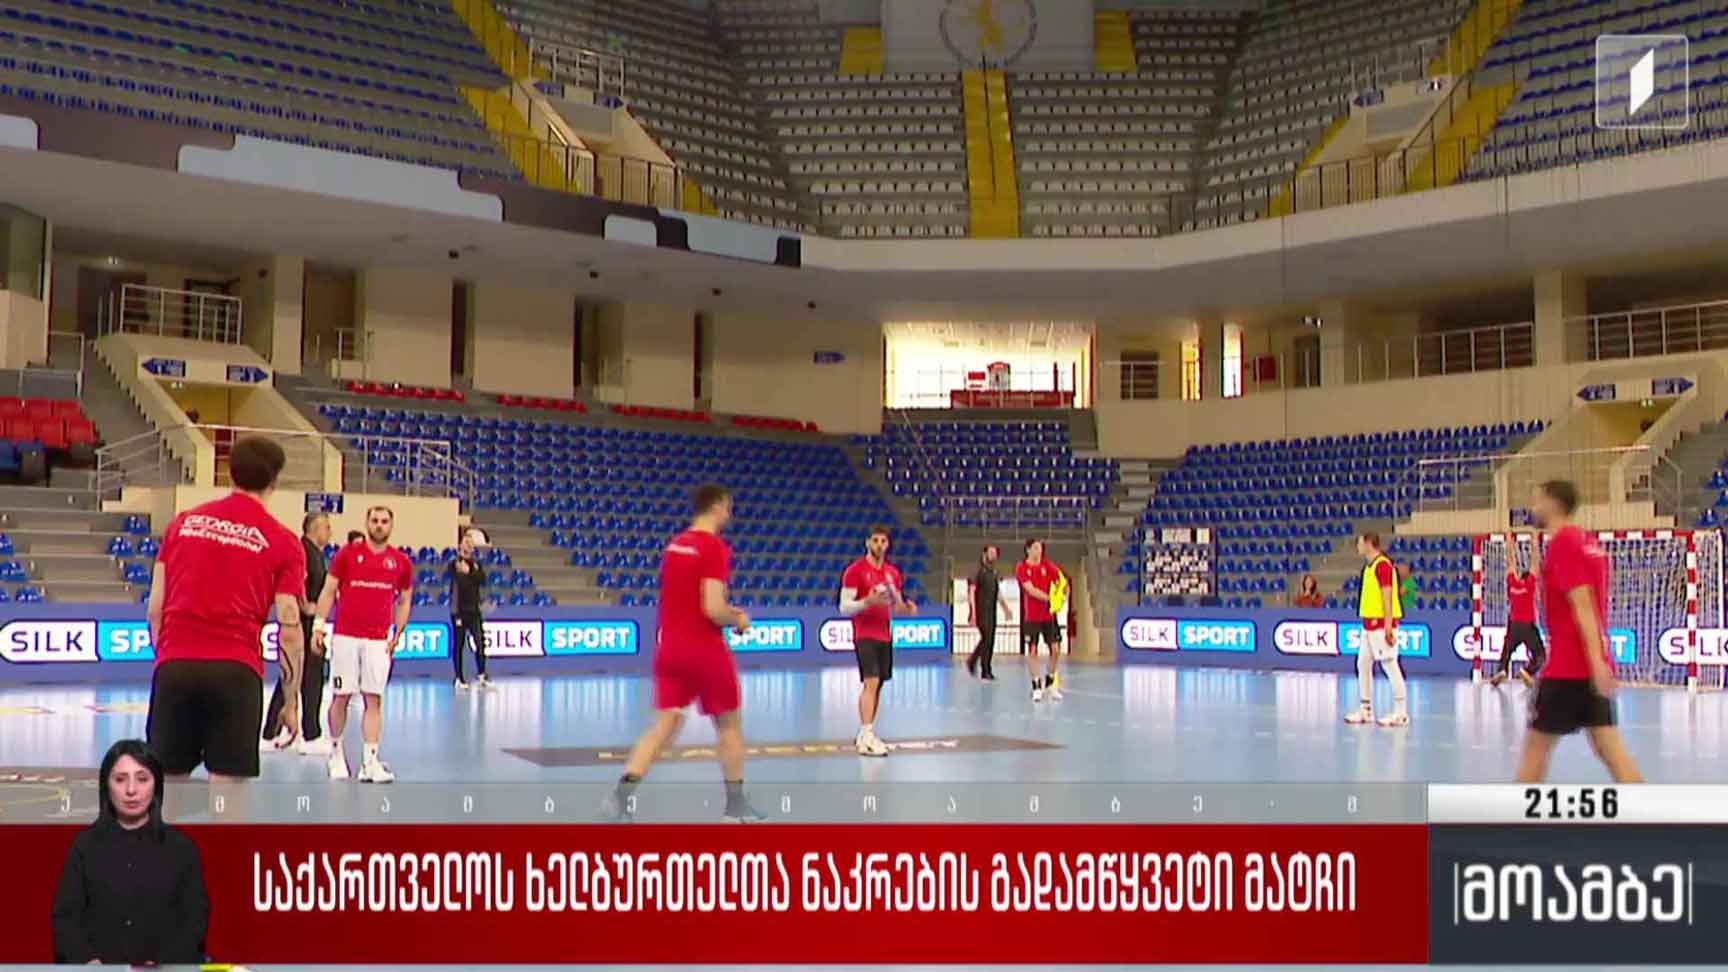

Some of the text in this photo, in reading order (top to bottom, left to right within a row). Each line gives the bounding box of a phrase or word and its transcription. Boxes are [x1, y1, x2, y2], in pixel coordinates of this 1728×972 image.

[184, 514, 270, 548] GEORGIA
[11, 630, 84, 652] SILK
[484, 626, 631, 649] SILK SPORT
[728, 625, 797, 646] SPORT
[827, 624, 941, 644] SIL PORT
[1129, 625, 1250, 647] SILK SPORT
[1282, 629, 1423, 651] SILK SRT
